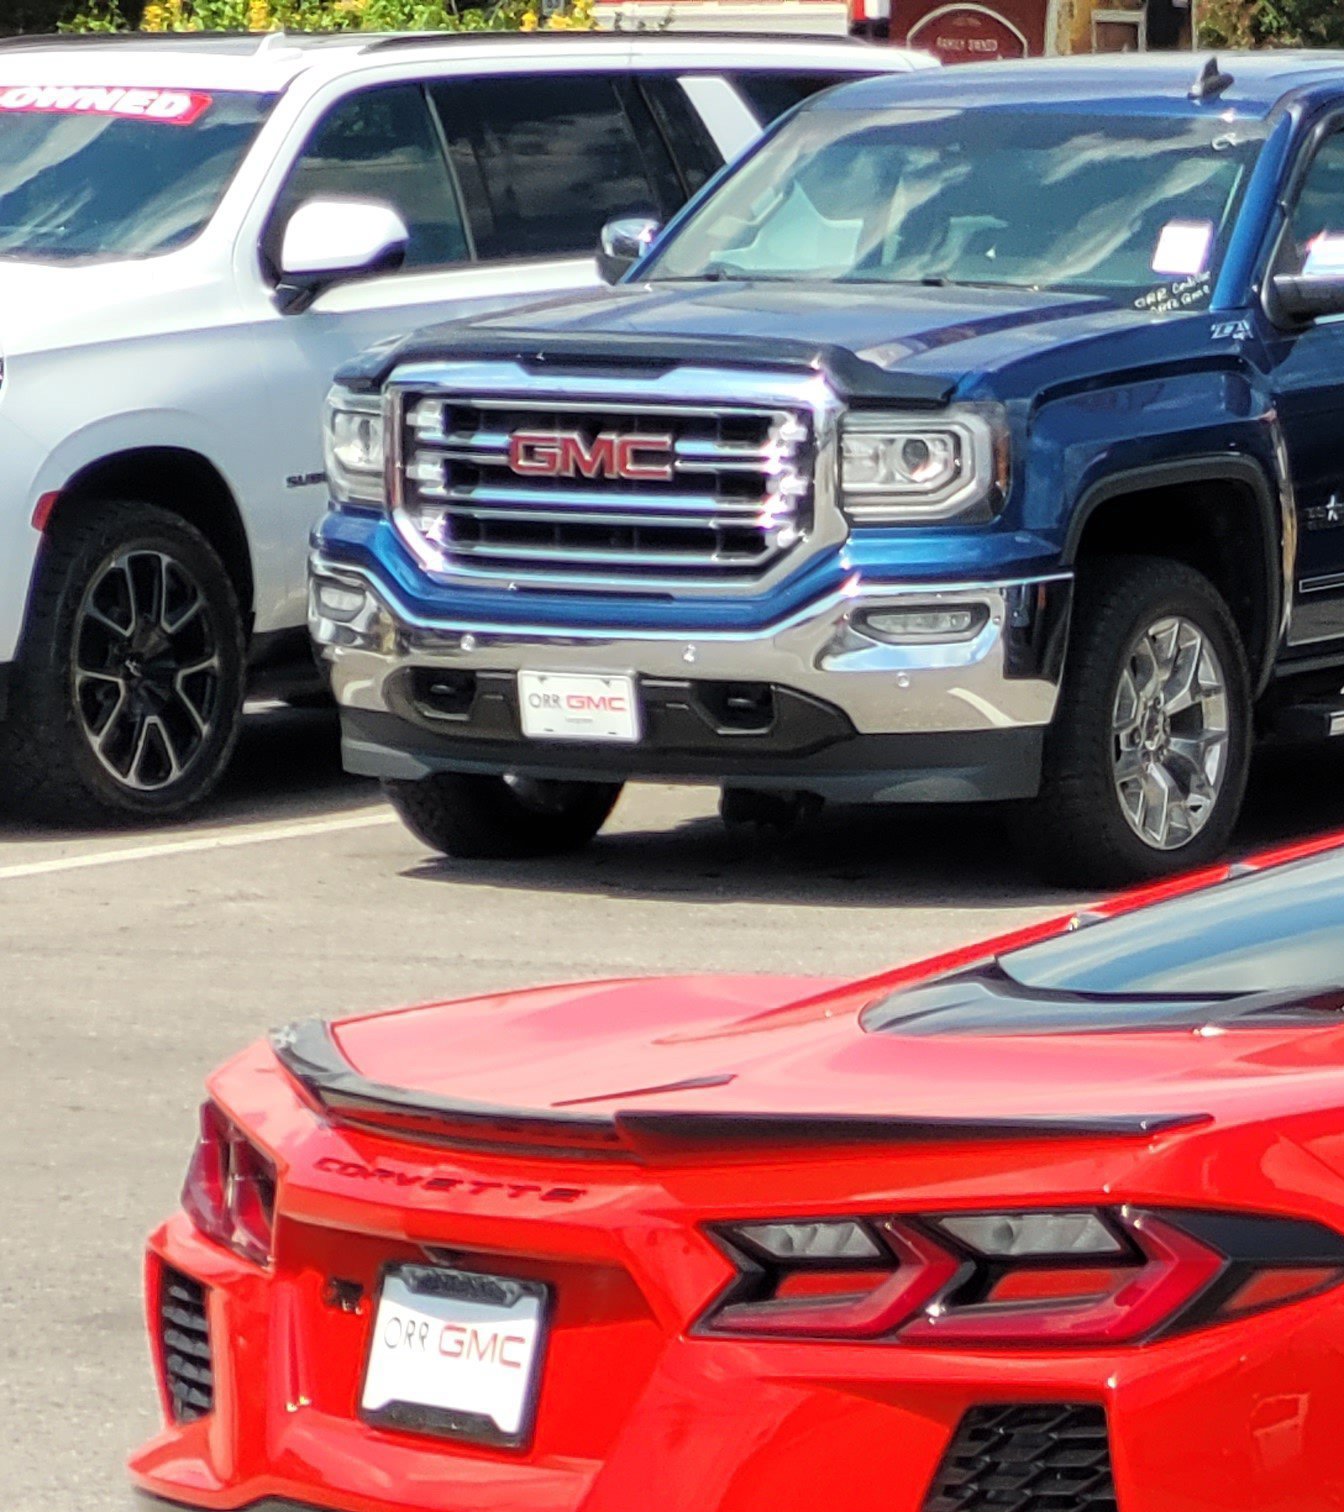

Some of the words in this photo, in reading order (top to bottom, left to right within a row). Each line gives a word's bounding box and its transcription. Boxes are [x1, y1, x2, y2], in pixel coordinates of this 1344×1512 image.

[509, 429, 673, 481] GMC
[528, 693, 562, 710] ORR
[566, 694, 627, 712] GMC
[313, 1157, 588, 1203] CORVETTE
[384, 1316, 430, 1350] ORR
[439, 1322, 526, 1370] GMC
